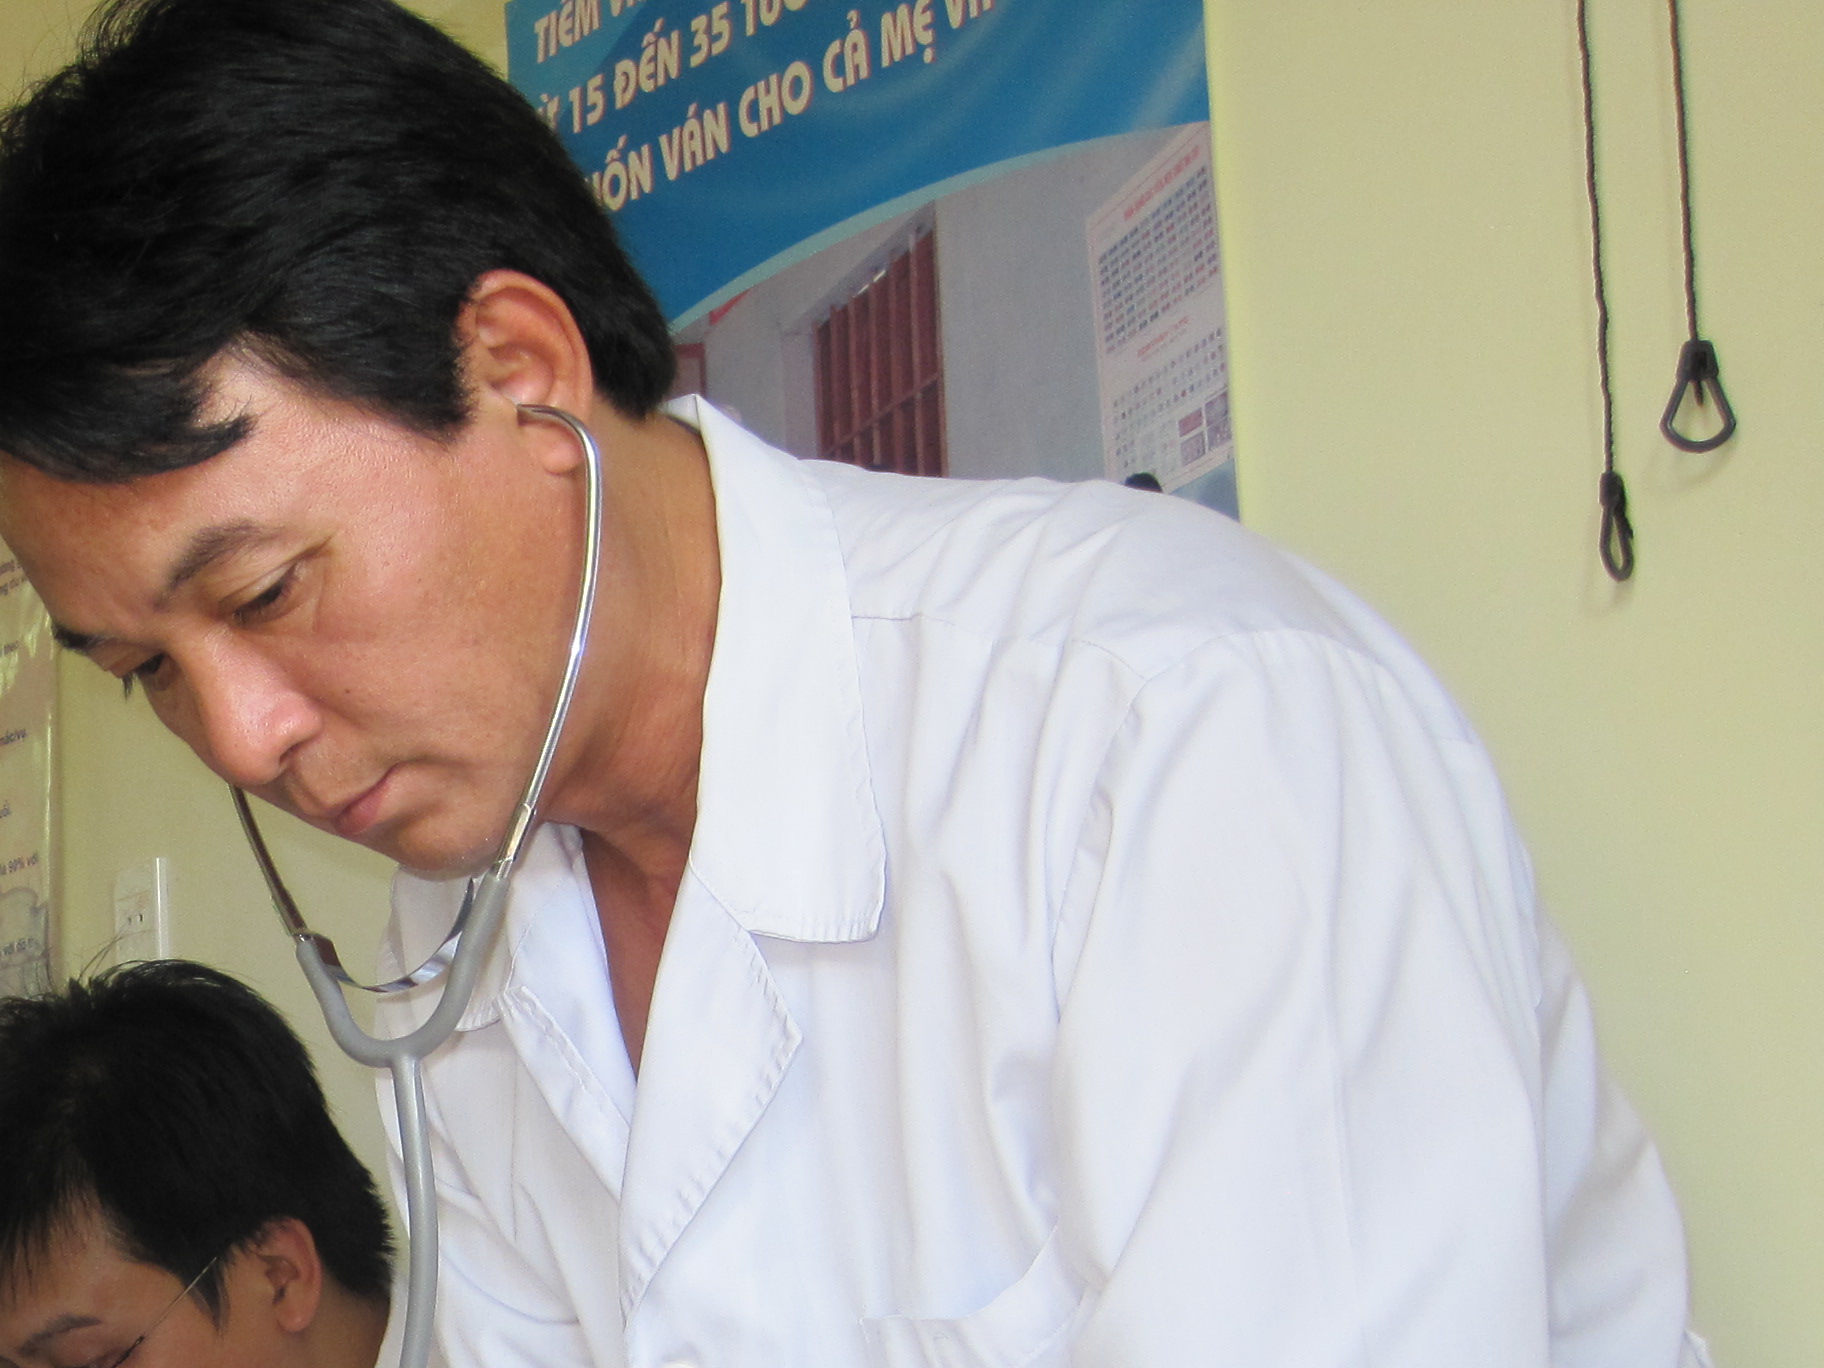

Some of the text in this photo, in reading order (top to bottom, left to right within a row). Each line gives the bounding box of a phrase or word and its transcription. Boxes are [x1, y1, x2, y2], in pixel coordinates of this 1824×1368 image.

[568, 73, 605, 134] 15
[613, 17, 681, 109] ĐẾN
[690, 2, 731, 68] 35
[660, 101, 730, 181] VÁN
[738, 60, 813, 138] CHO
[823, 9, 871, 93] CẢ
[881, 0, 936, 68] MẸ
